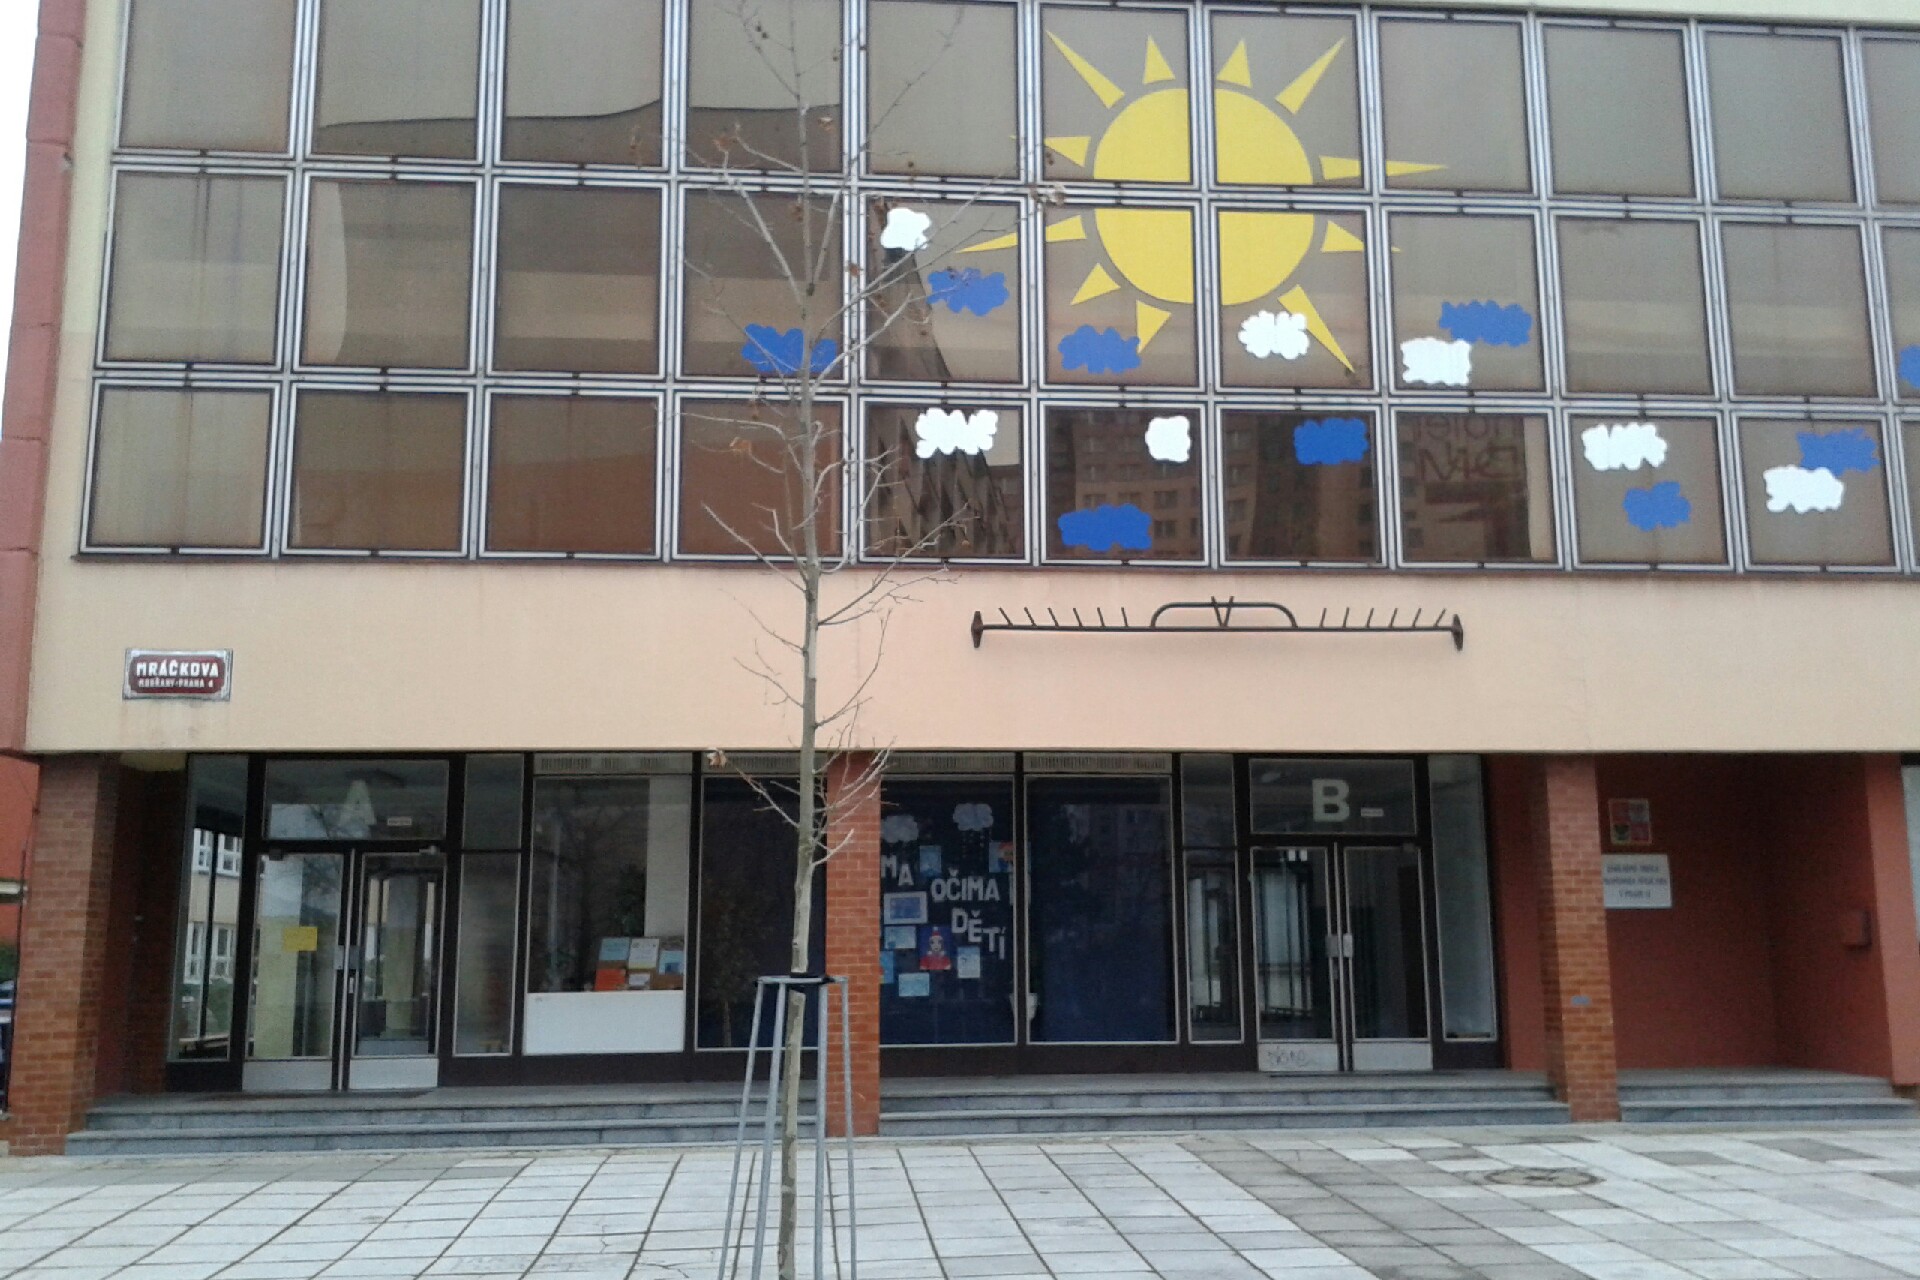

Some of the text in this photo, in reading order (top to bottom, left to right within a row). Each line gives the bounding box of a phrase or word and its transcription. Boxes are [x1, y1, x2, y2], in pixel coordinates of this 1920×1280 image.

[136, 659, 219, 677] MRÁČKOVA
[339, 779, 378, 826] A
[1312, 778, 1350, 822] B
[931, 868, 1001, 903] OČIMA
[951, 907, 1006, 960] DĚTÍ
